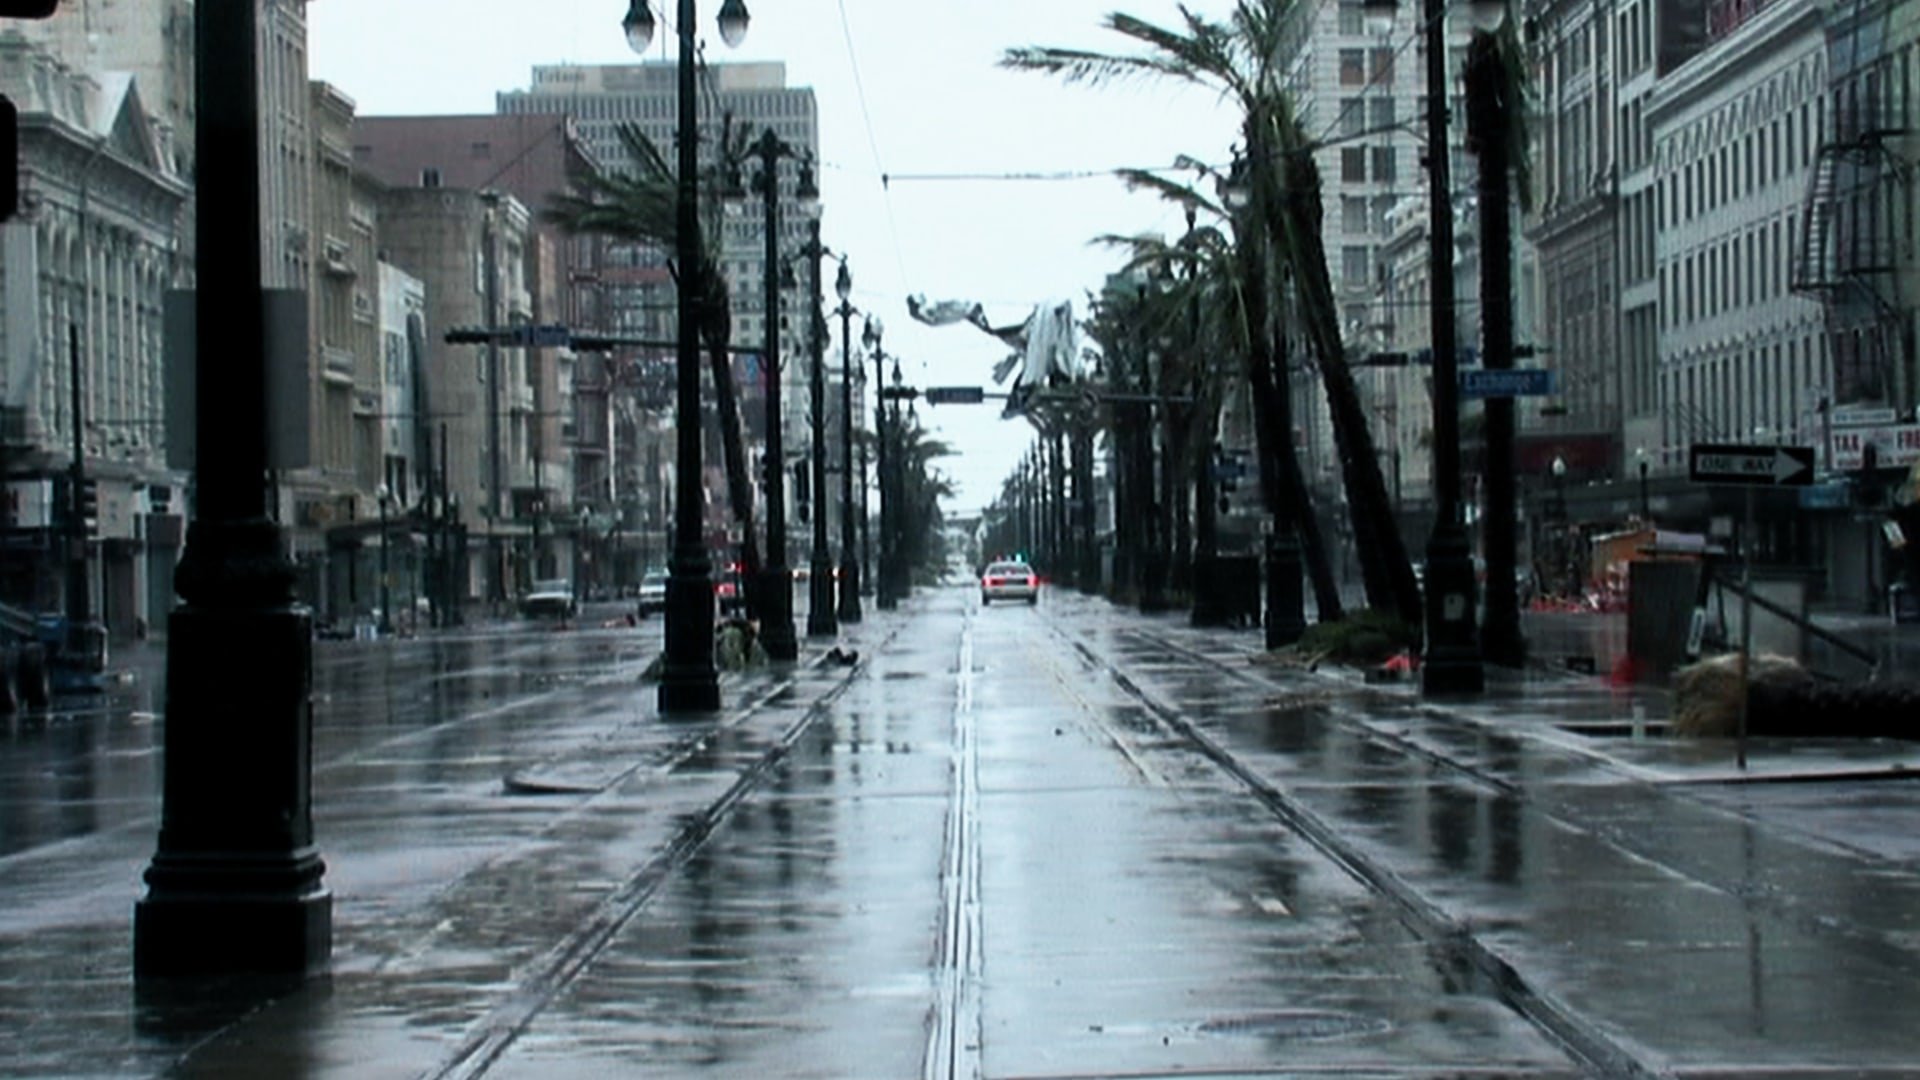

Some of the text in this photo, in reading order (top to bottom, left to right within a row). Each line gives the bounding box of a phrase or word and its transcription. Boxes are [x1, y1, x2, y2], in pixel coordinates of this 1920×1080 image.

[1834, 434, 1860, 453] TAX
[1701, 455, 1776, 474] ONE WAY
